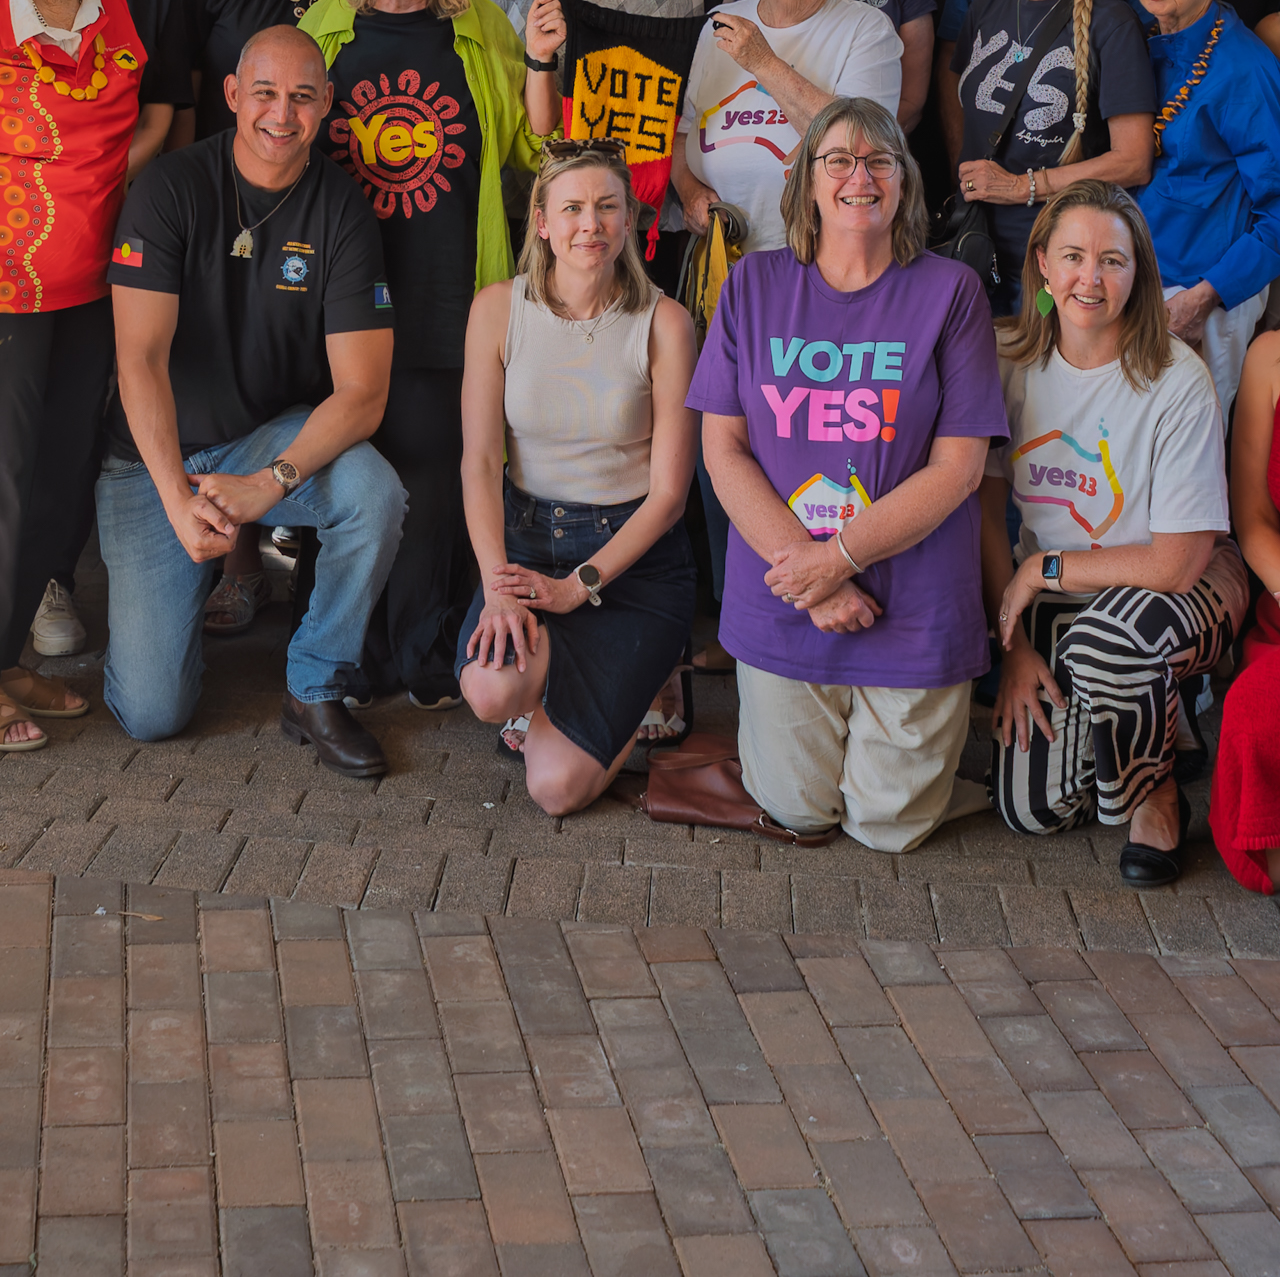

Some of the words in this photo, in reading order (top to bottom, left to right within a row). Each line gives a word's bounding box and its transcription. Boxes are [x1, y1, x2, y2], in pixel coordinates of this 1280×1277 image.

[583, 57, 677, 107] VOTE
[958, 29, 1076, 131] YES
[348, 114, 438, 165] Yes
[581, 101, 668, 154] YES
[770, 337, 906, 383] VOTE
[761, 384, 901, 443] YES!
[1028, 462, 1098, 497] yes23
[803, 503, 855, 520] yes23
